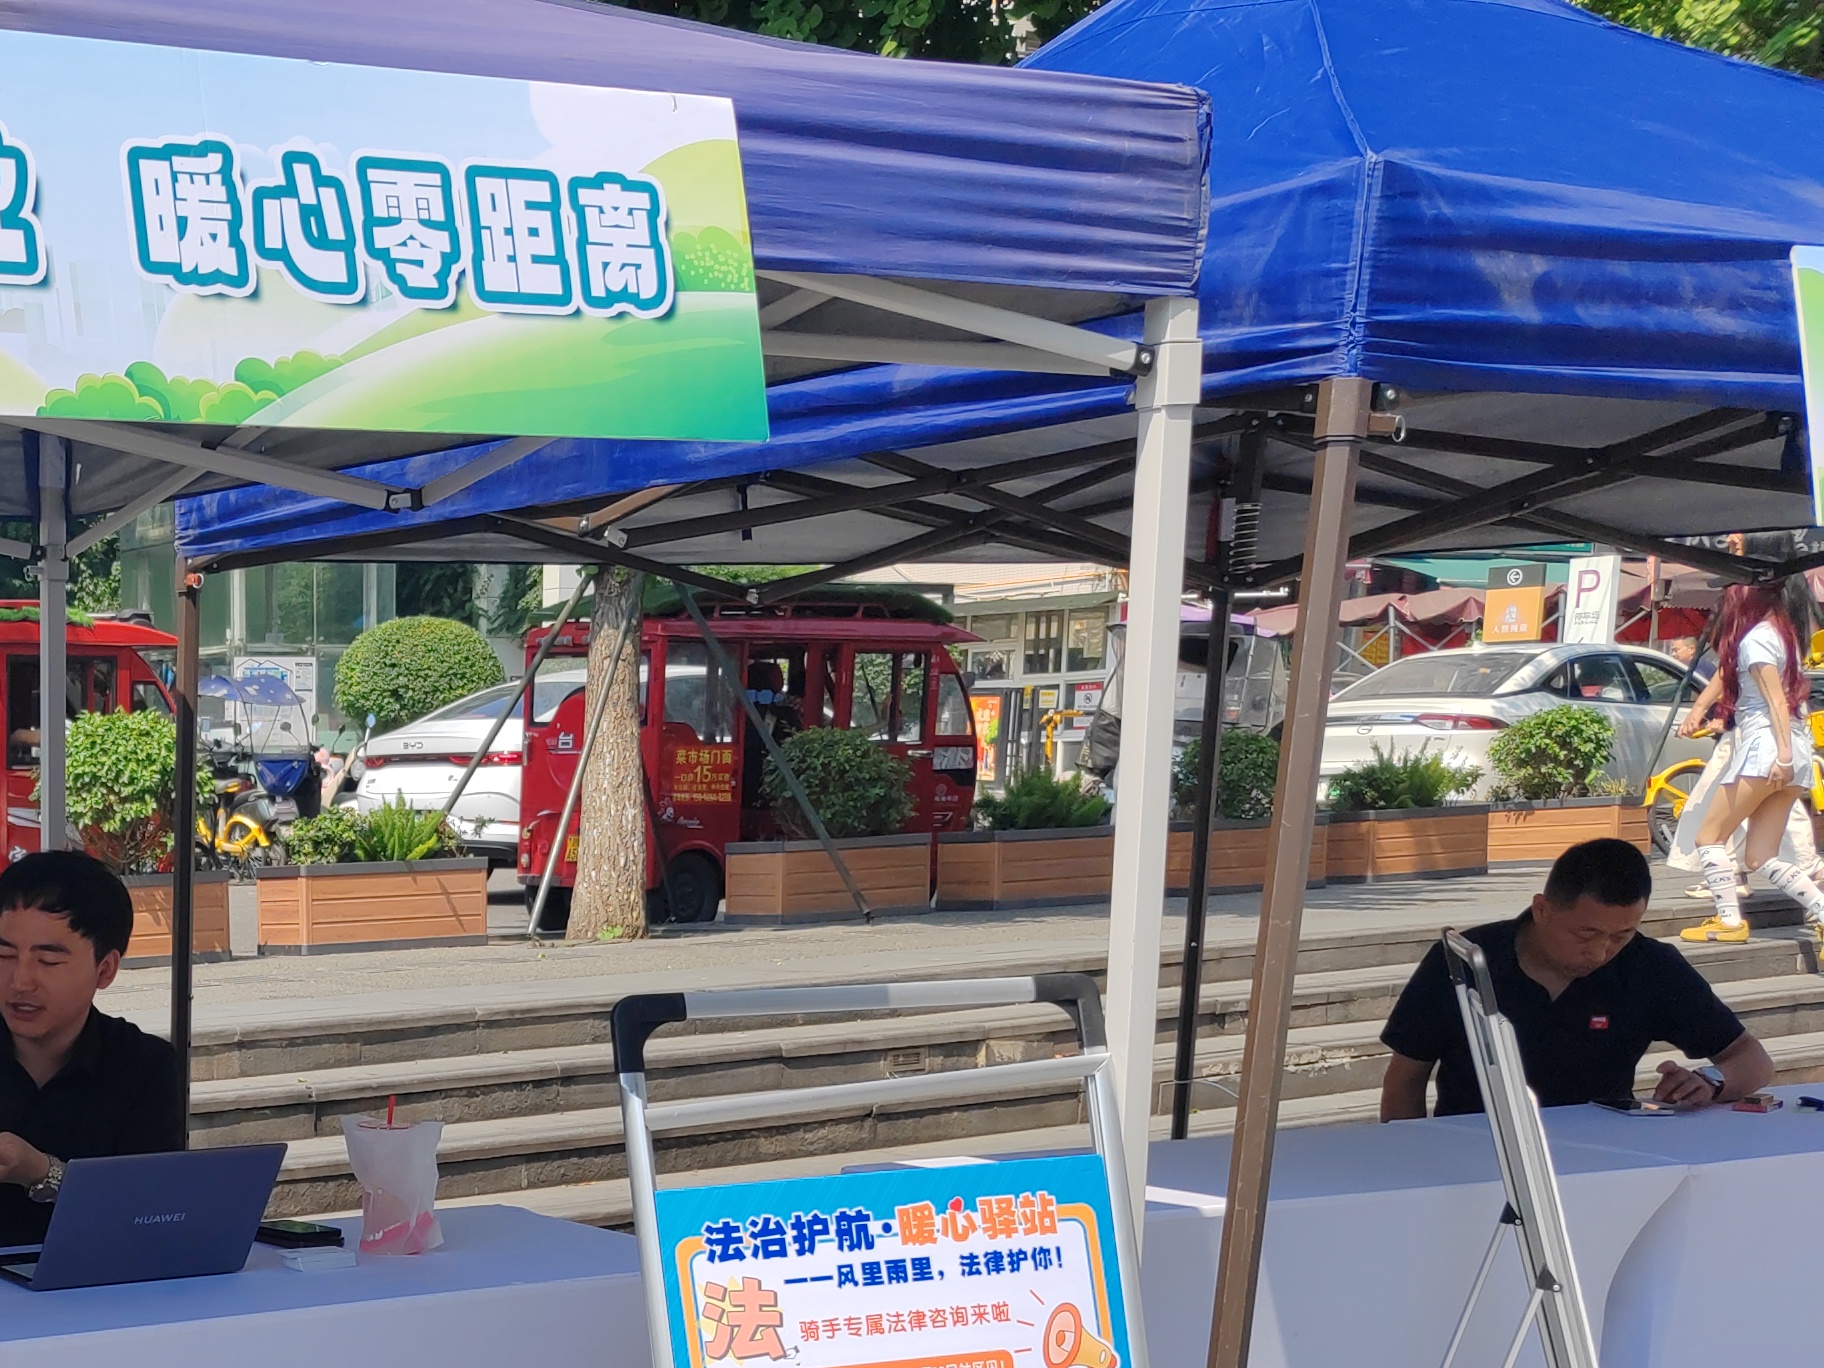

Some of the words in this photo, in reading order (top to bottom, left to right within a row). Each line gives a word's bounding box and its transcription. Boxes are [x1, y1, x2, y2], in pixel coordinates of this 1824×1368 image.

[130, 138, 673, 310] 暖心零距离
[1575, 568, 1601, 609] P
[403, 741, 424, 750] BYD
[134, 1212, 186, 1225] HUAWEI
[697, 1272, 788, 1366] 法
[798, 1300, 1012, 1343] 骑手专属法律咨询来啦
